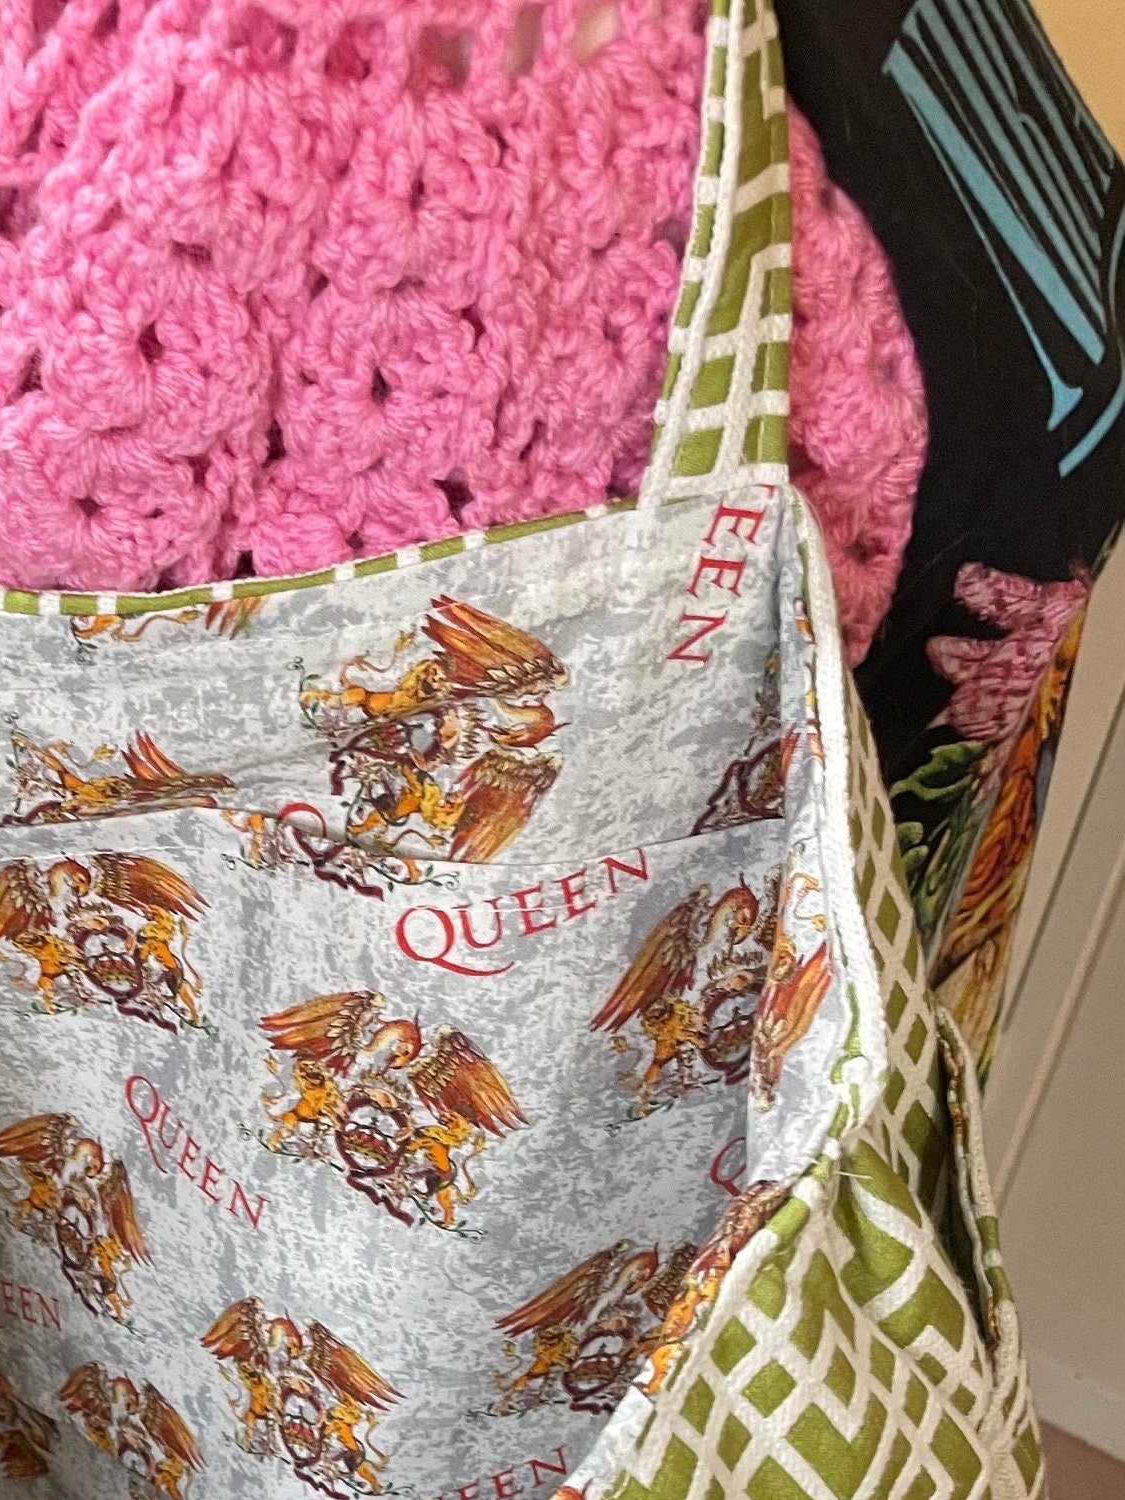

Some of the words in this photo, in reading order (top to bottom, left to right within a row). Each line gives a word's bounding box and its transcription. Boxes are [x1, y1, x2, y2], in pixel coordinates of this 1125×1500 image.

[665, 483, 775, 665] EEN
[394, 846, 651, 977] QUEEN
[124, 1074, 269, 1230] QUEEN
